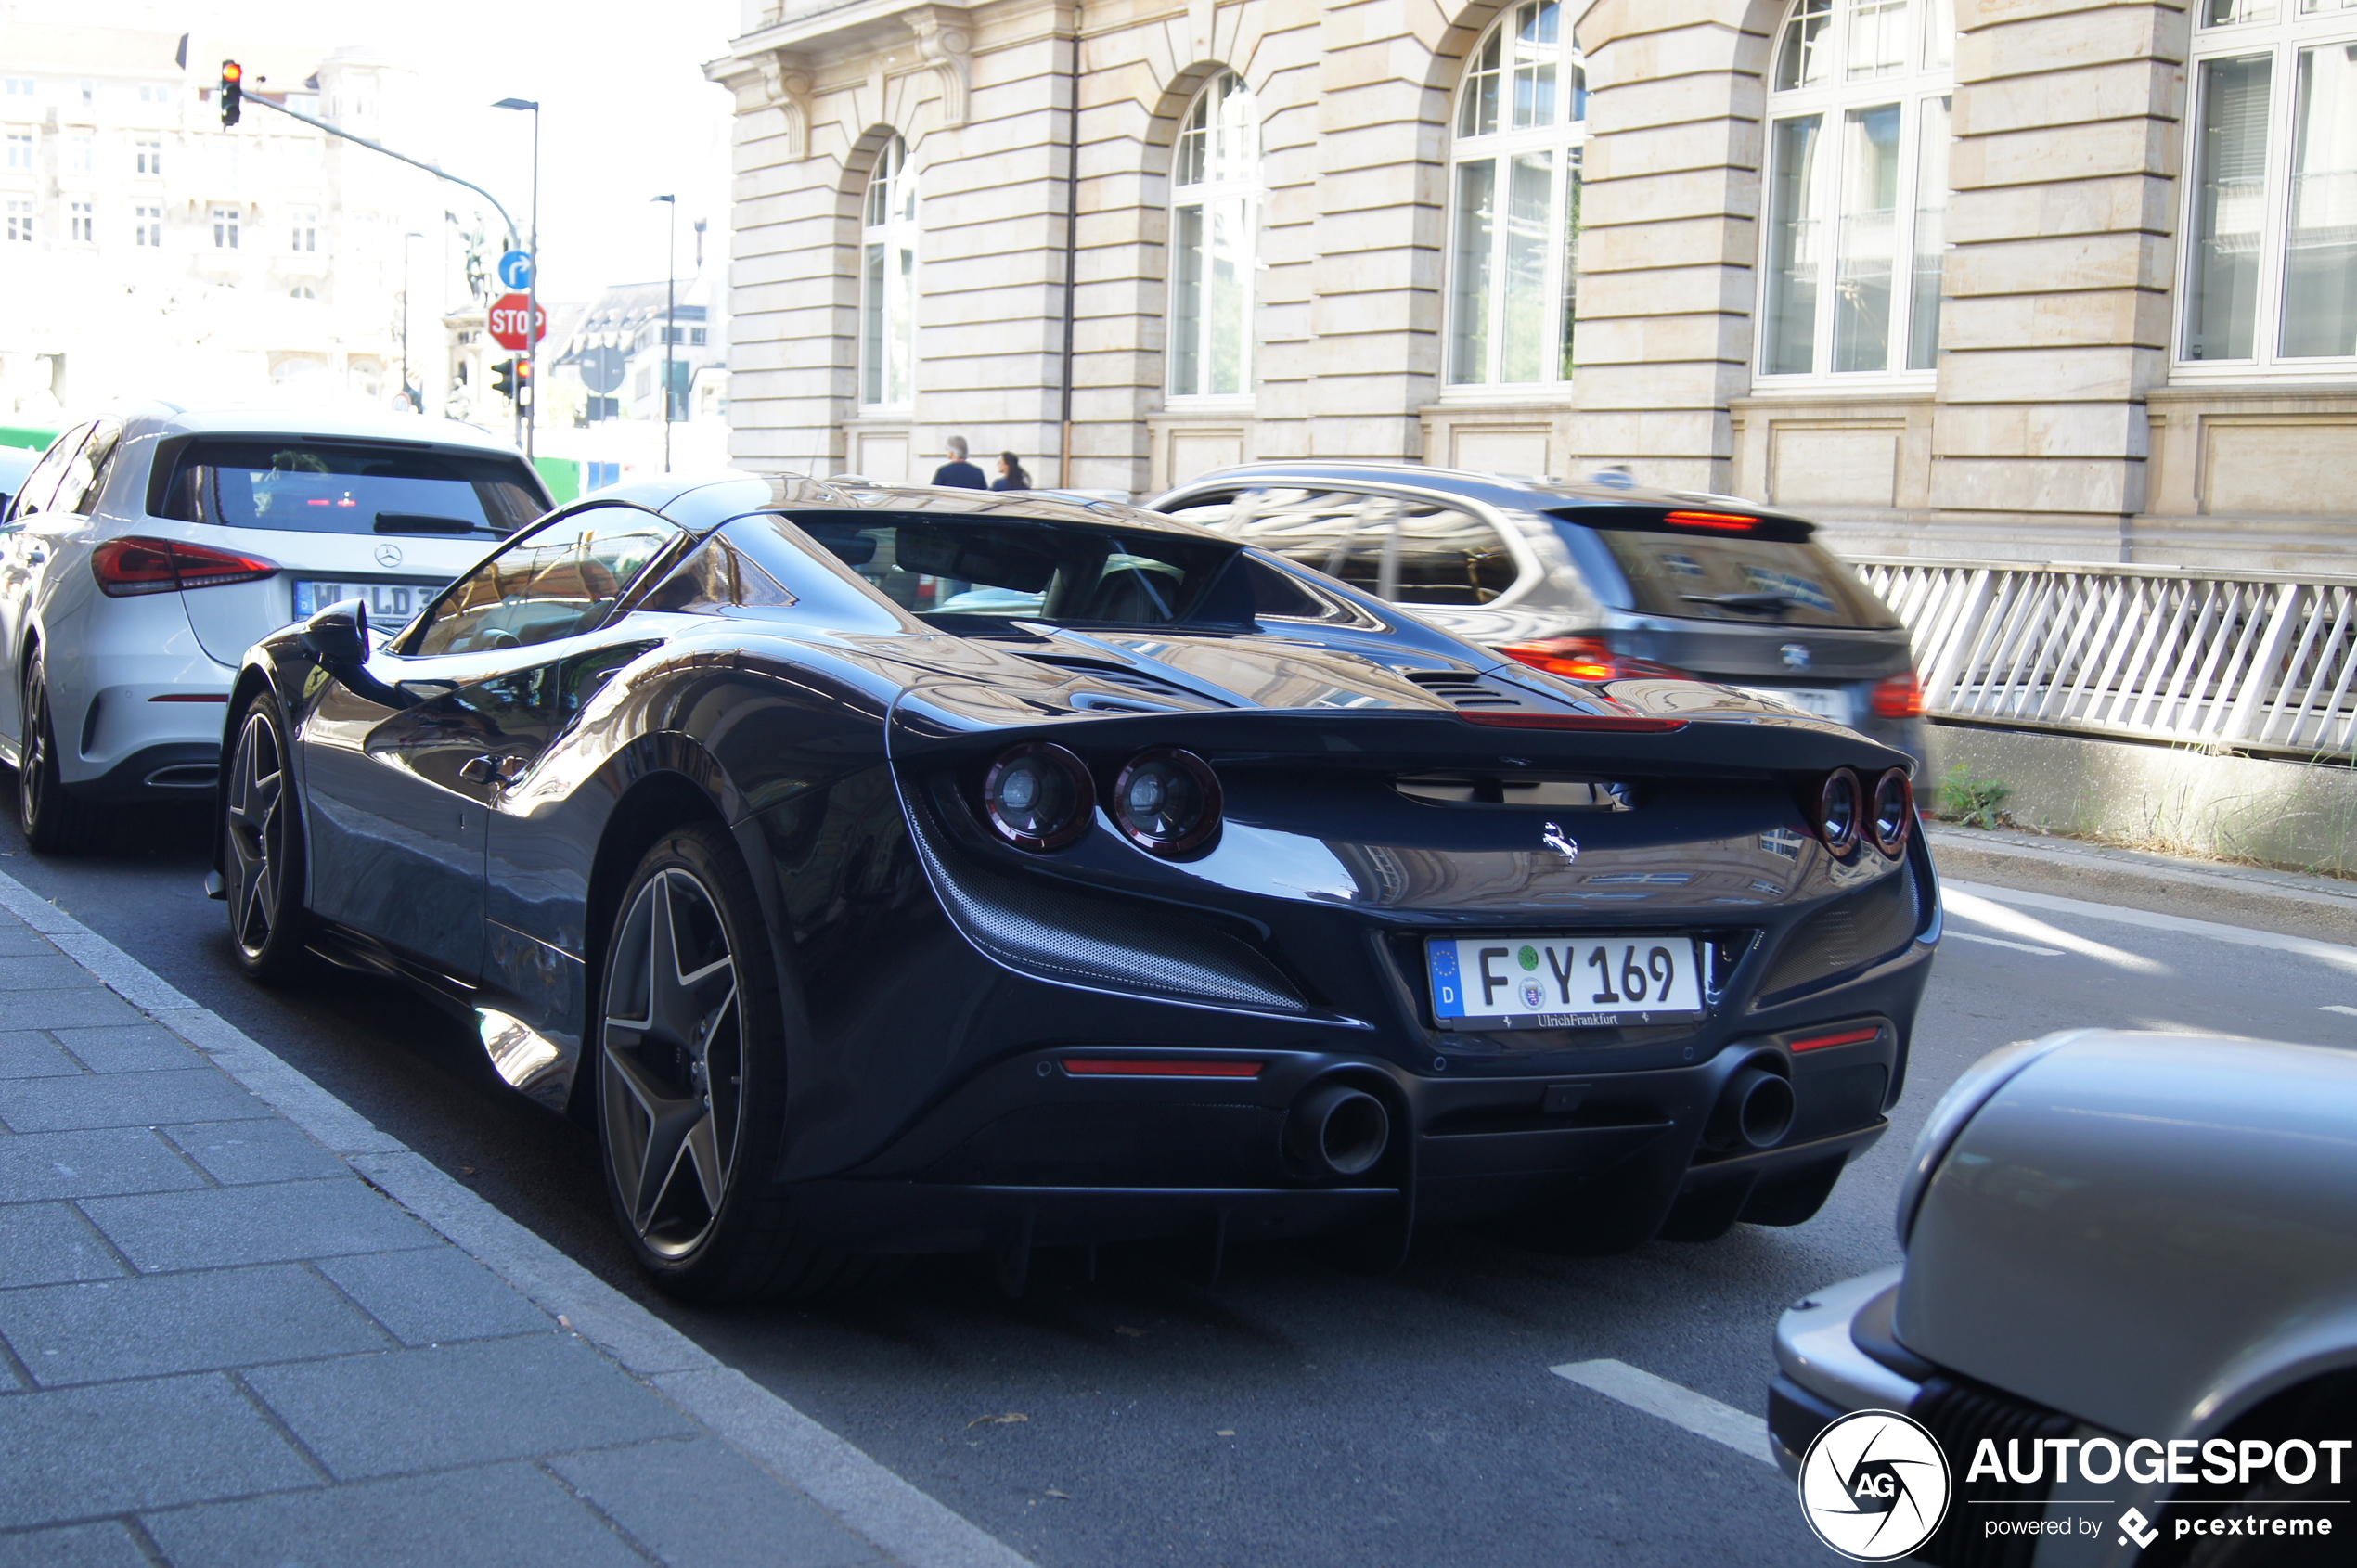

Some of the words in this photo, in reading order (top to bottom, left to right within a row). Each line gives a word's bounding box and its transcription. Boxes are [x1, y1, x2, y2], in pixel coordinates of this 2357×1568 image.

[301, 601, 308, 610] D
[373, 586, 410, 615] LD
[418, 588, 443, 612] 3
[1478, 947, 1509, 1006] F
[1589, 945, 1674, 1003] 169
[1441, 986, 1454, 1004] D
[1538, 1013, 1618, 1027] UlrichFrankfurt
